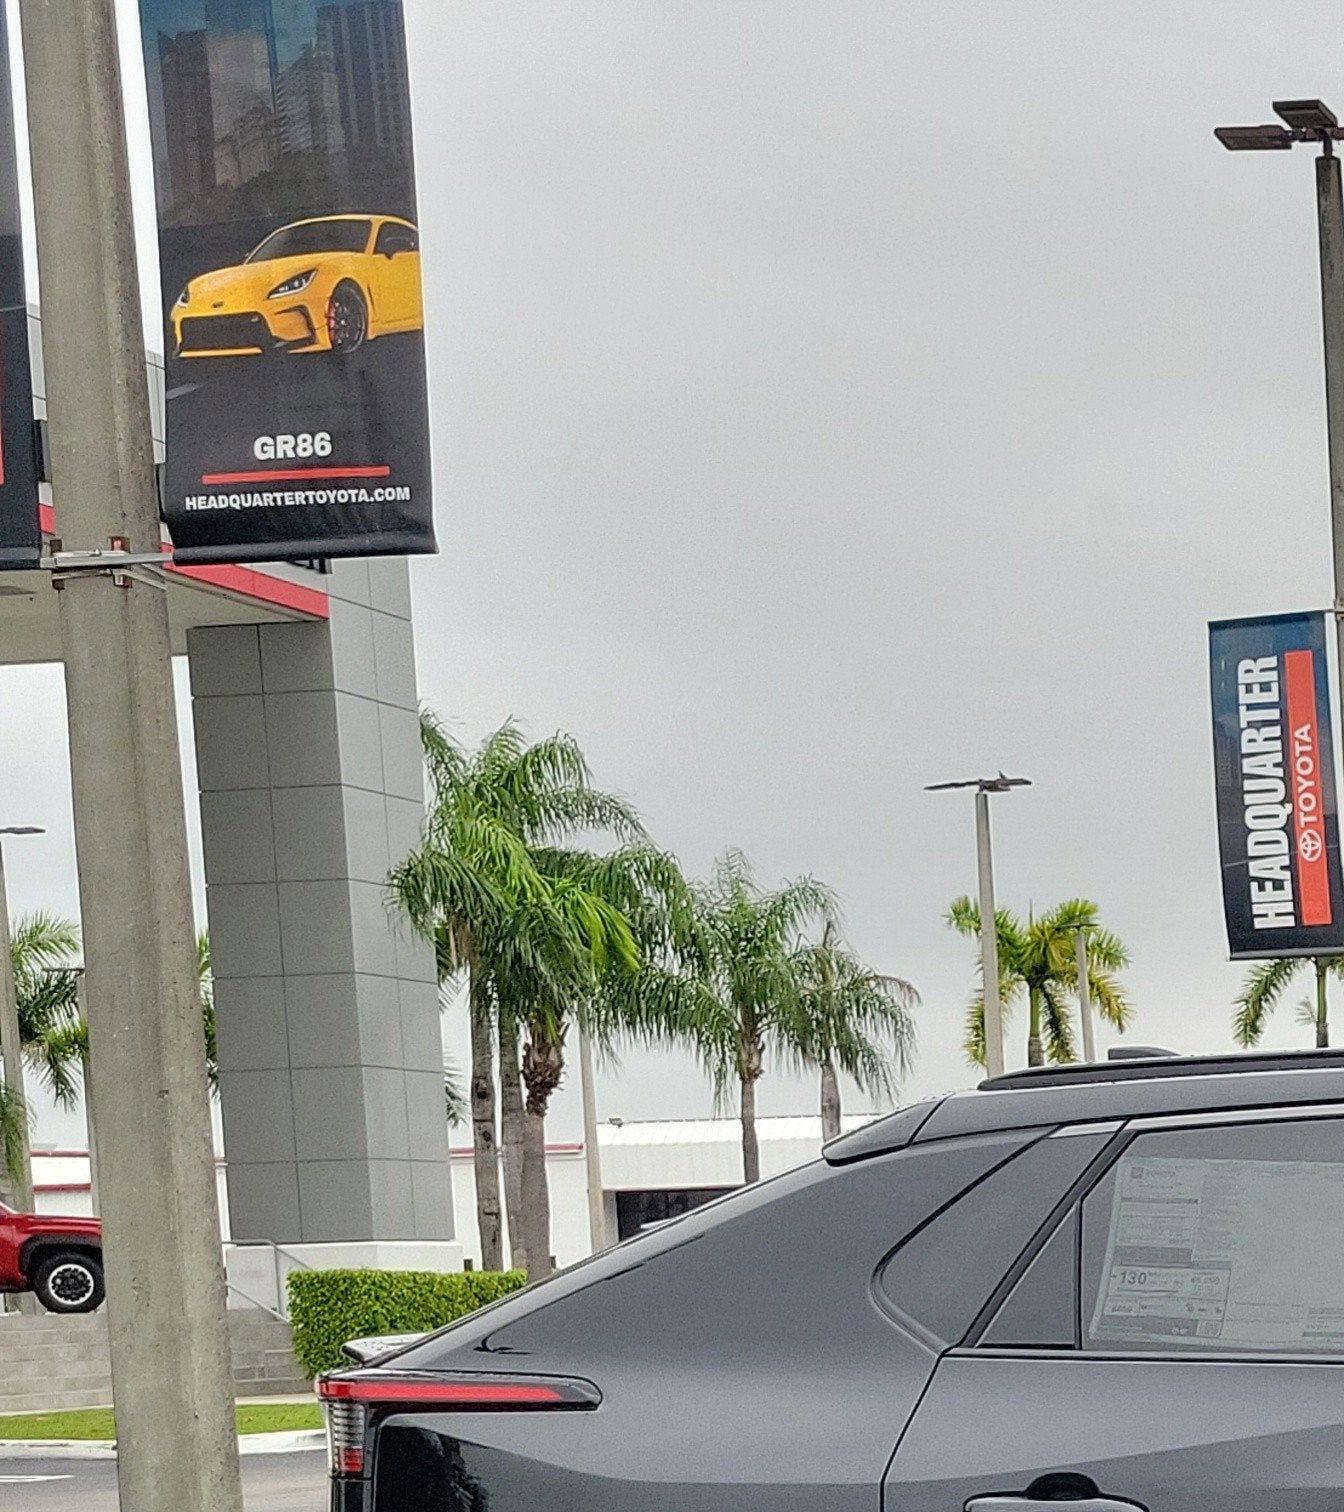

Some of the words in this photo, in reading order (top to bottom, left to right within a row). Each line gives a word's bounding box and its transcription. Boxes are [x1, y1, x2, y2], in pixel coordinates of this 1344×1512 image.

[253, 431, 333, 461] GR86
[185, 486, 411, 511] HEADQUARTERTOYOTA.COM
[1293, 723, 1321, 828] TOYOTA
[1237, 655, 1297, 930] HEADQUARTER
[1120, 1271, 1147, 1285] 130
